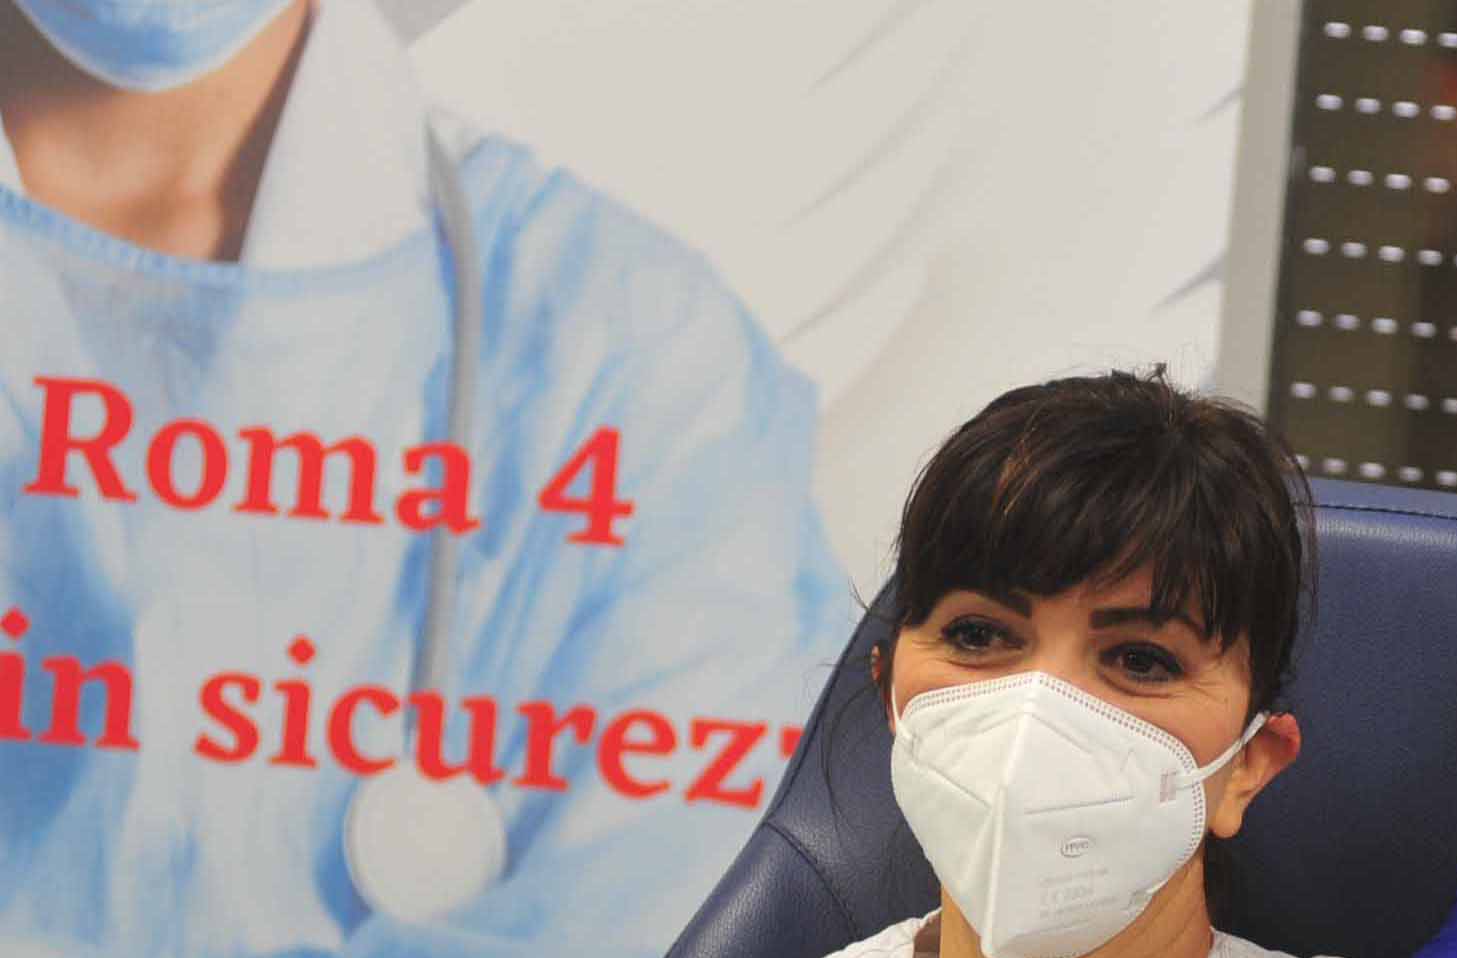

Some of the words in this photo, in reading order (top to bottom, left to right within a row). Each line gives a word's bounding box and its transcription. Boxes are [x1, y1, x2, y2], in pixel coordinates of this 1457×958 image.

[23, 376, 480, 536] Roma
[537, 425, 636, 547] 4
[0, 608, 140, 752] in
[194, 635, 802, 811] sicurez
